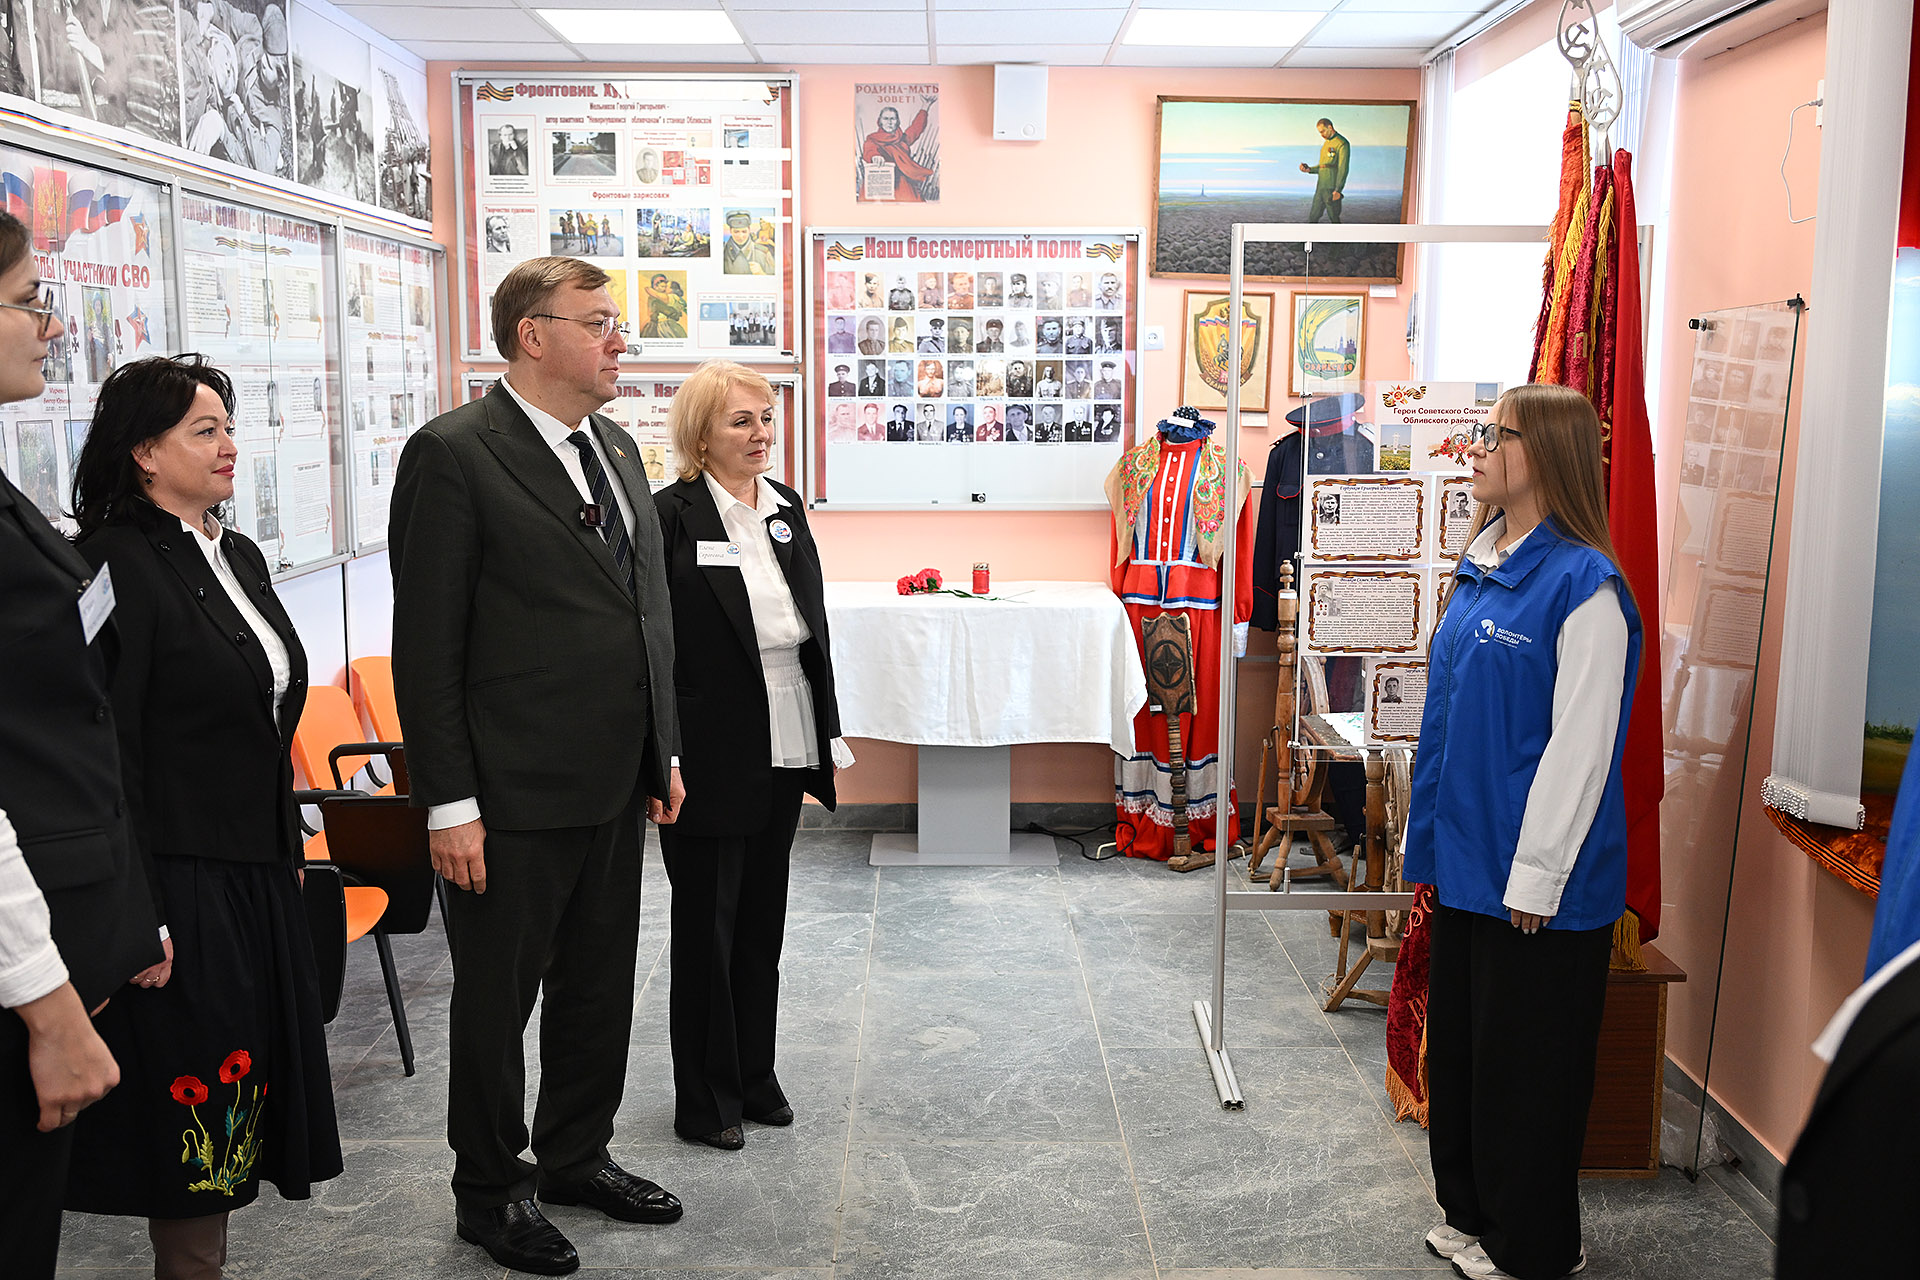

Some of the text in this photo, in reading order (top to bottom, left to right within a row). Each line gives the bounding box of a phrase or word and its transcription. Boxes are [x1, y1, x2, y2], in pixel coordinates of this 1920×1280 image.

[515, 82, 598, 98] Фронтовик.
[856, 85, 940, 94] РОДИНА-МАТЬ
[877, 95, 916, 103] ЗОВЕТ!
[592, 191, 670, 200] Фронтовые зарисовки
[865, 234, 1082, 260] Наш бессмертный полк
[63, 259, 117, 286] УЧАСТНИКИ
[121, 263, 150, 289] СВО
[1393, 407, 1489, 416] Герои Советского Союза
[1402, 416, 1479, 424] Обливского района
[1494, 632, 1520, 645] ПОБЕДЫ
